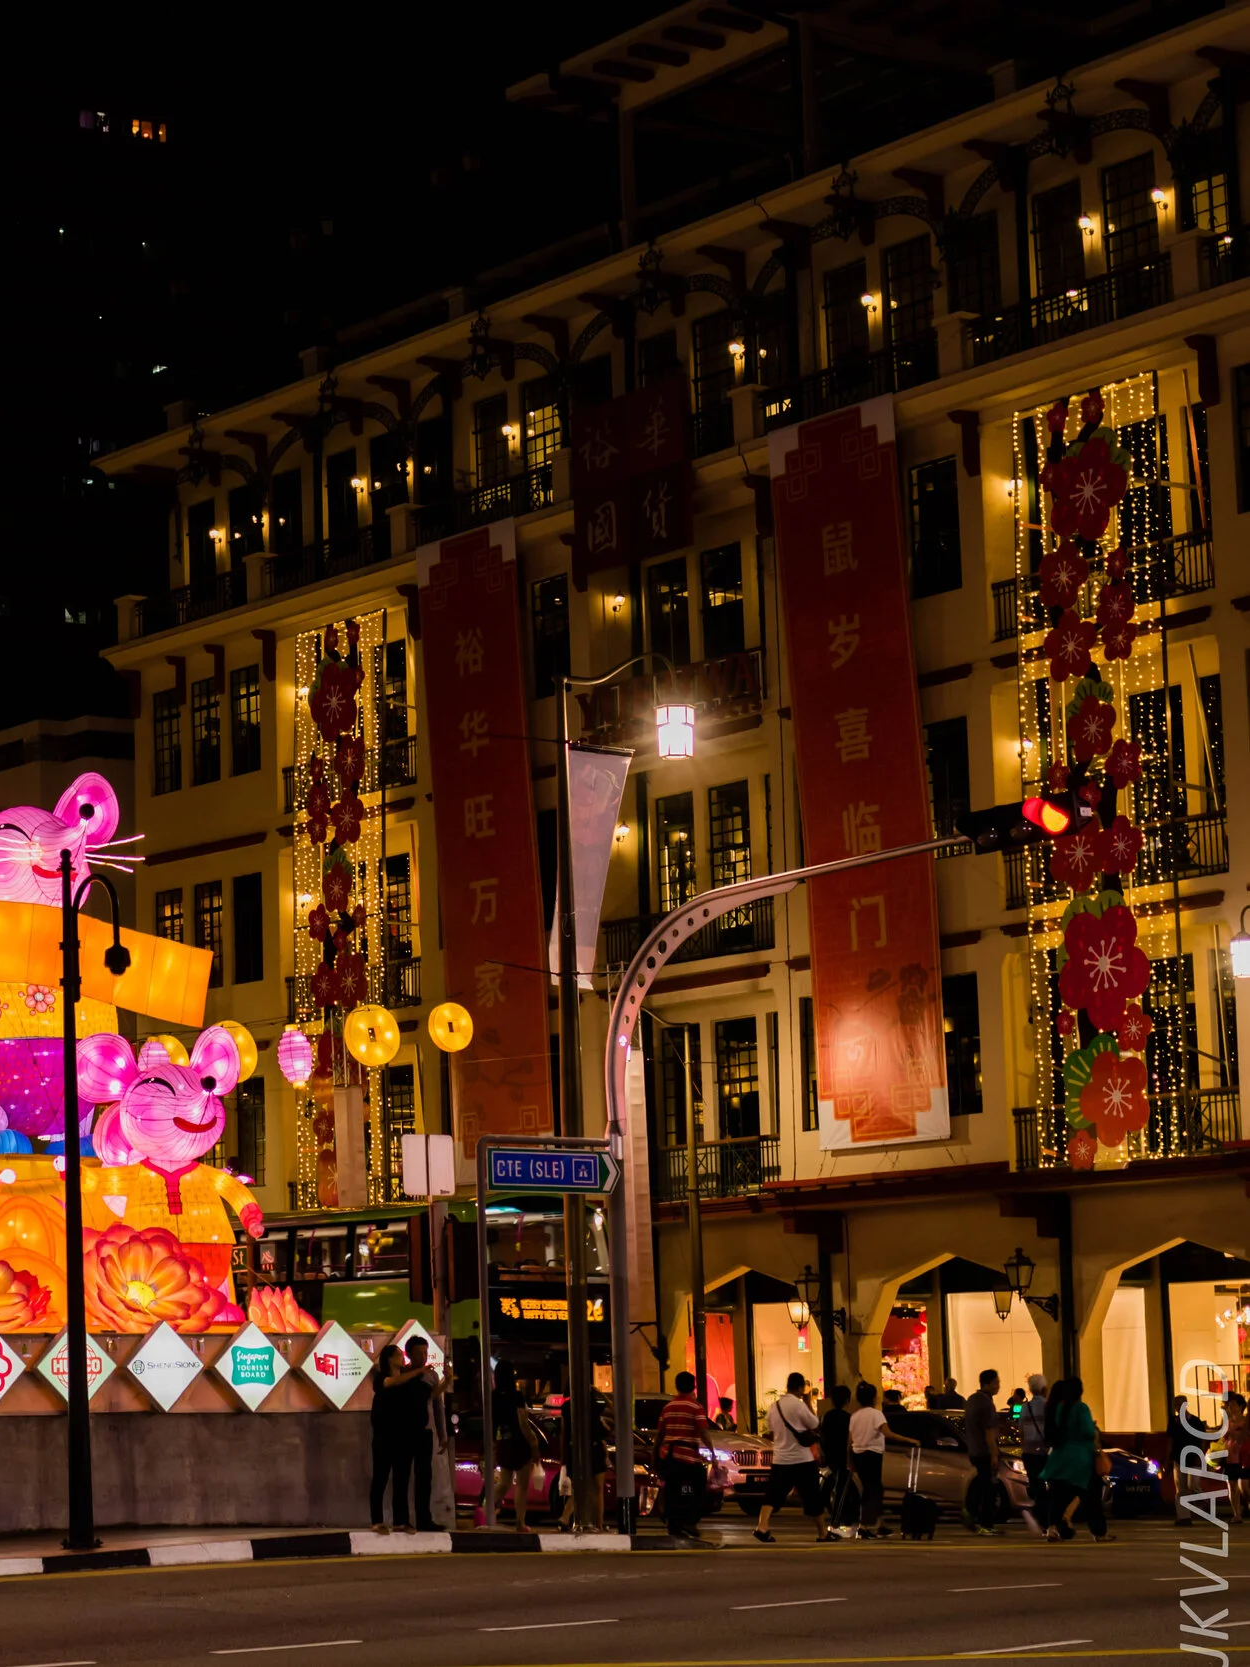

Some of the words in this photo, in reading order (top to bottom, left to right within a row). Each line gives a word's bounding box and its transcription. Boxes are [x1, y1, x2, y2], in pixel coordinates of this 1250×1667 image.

[820, 522, 889, 951] 鼠岁喜临门
[453, 628, 506, 1009] 裕华旺万家
[496, 1160, 522, 1177] CTE
[529, 1160, 565, 1180] (SLE)
[233, 1250, 244, 1265] St
[236, 1350, 269, 1365] Singapore
